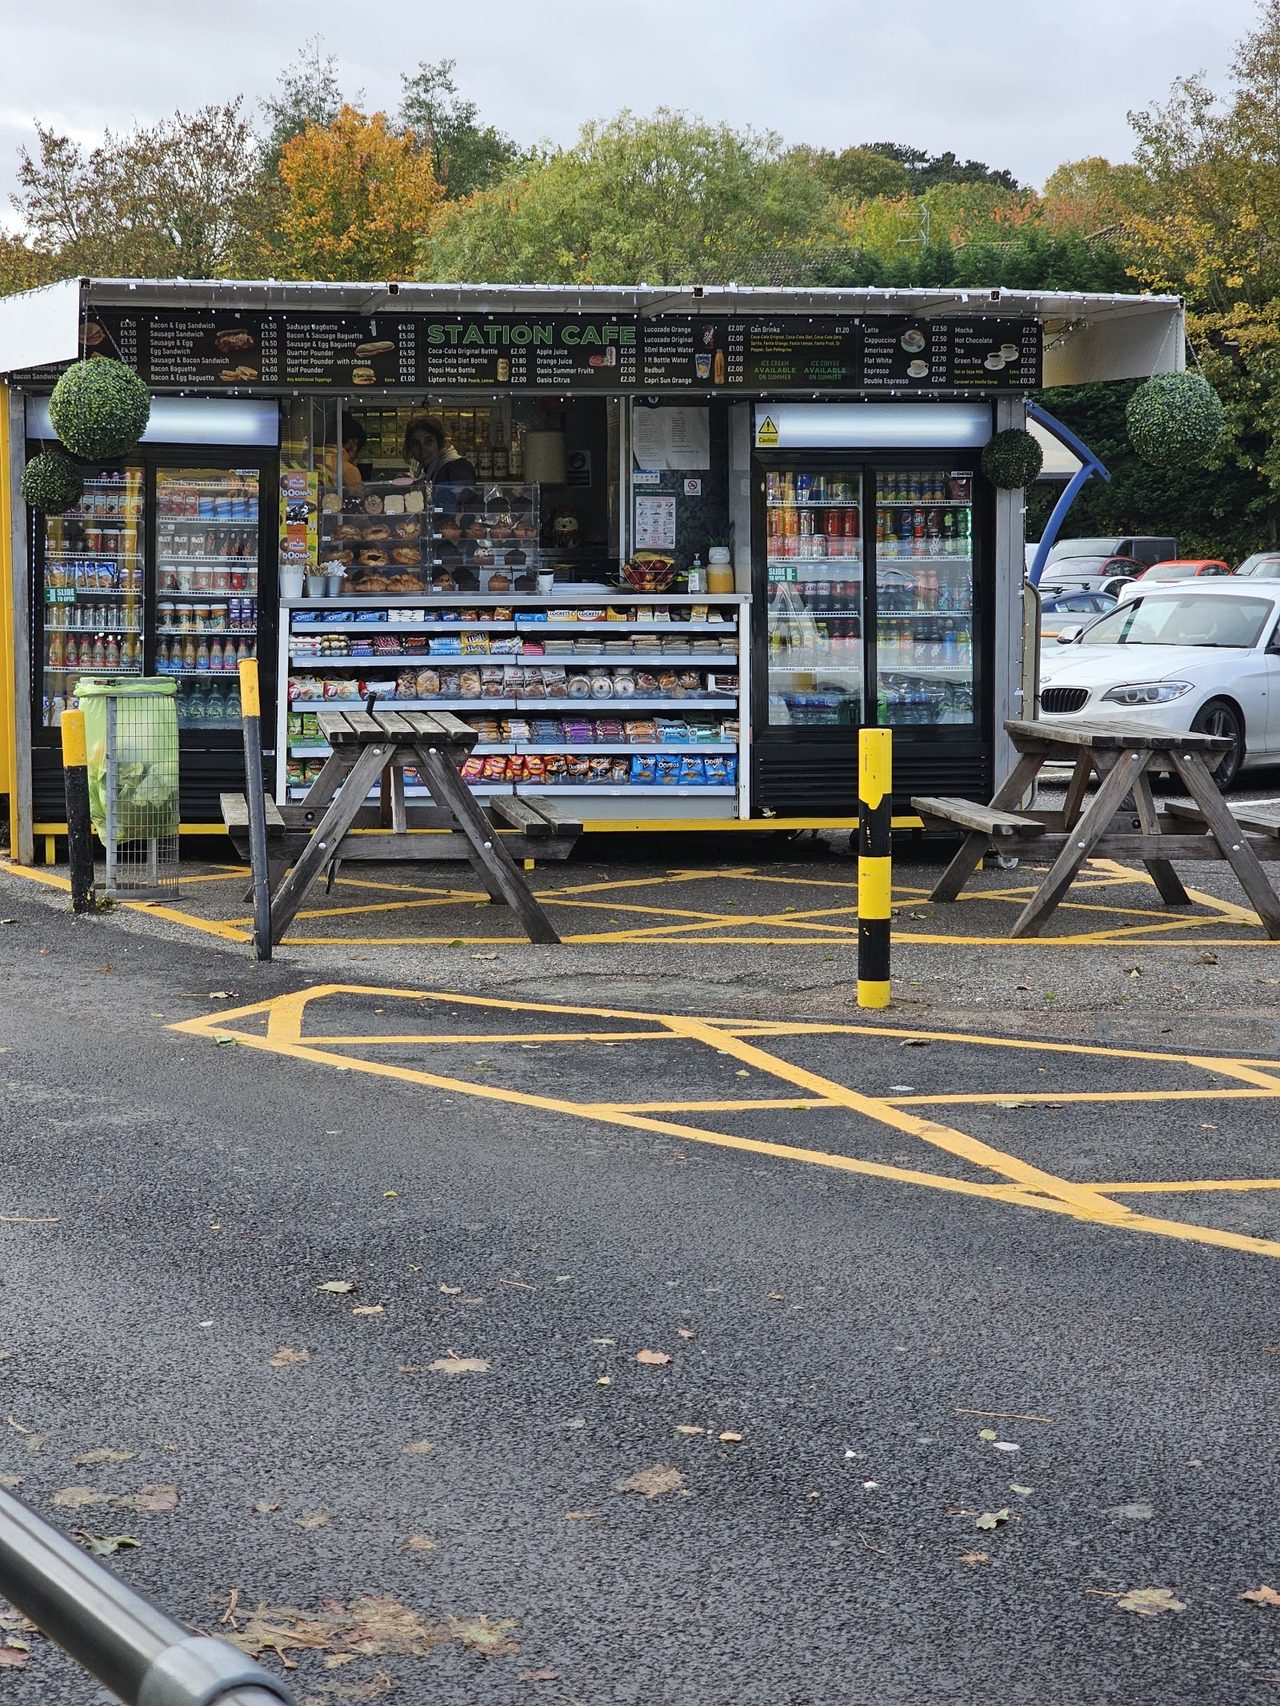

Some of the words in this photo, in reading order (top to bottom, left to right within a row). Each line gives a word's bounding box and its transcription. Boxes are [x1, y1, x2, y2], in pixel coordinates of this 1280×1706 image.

[427, 325, 553, 344] STATION
[561, 326, 636, 344] CAFE
[768, 568, 786, 576] SLIDE
[57, 588, 75, 596] SLIDE
